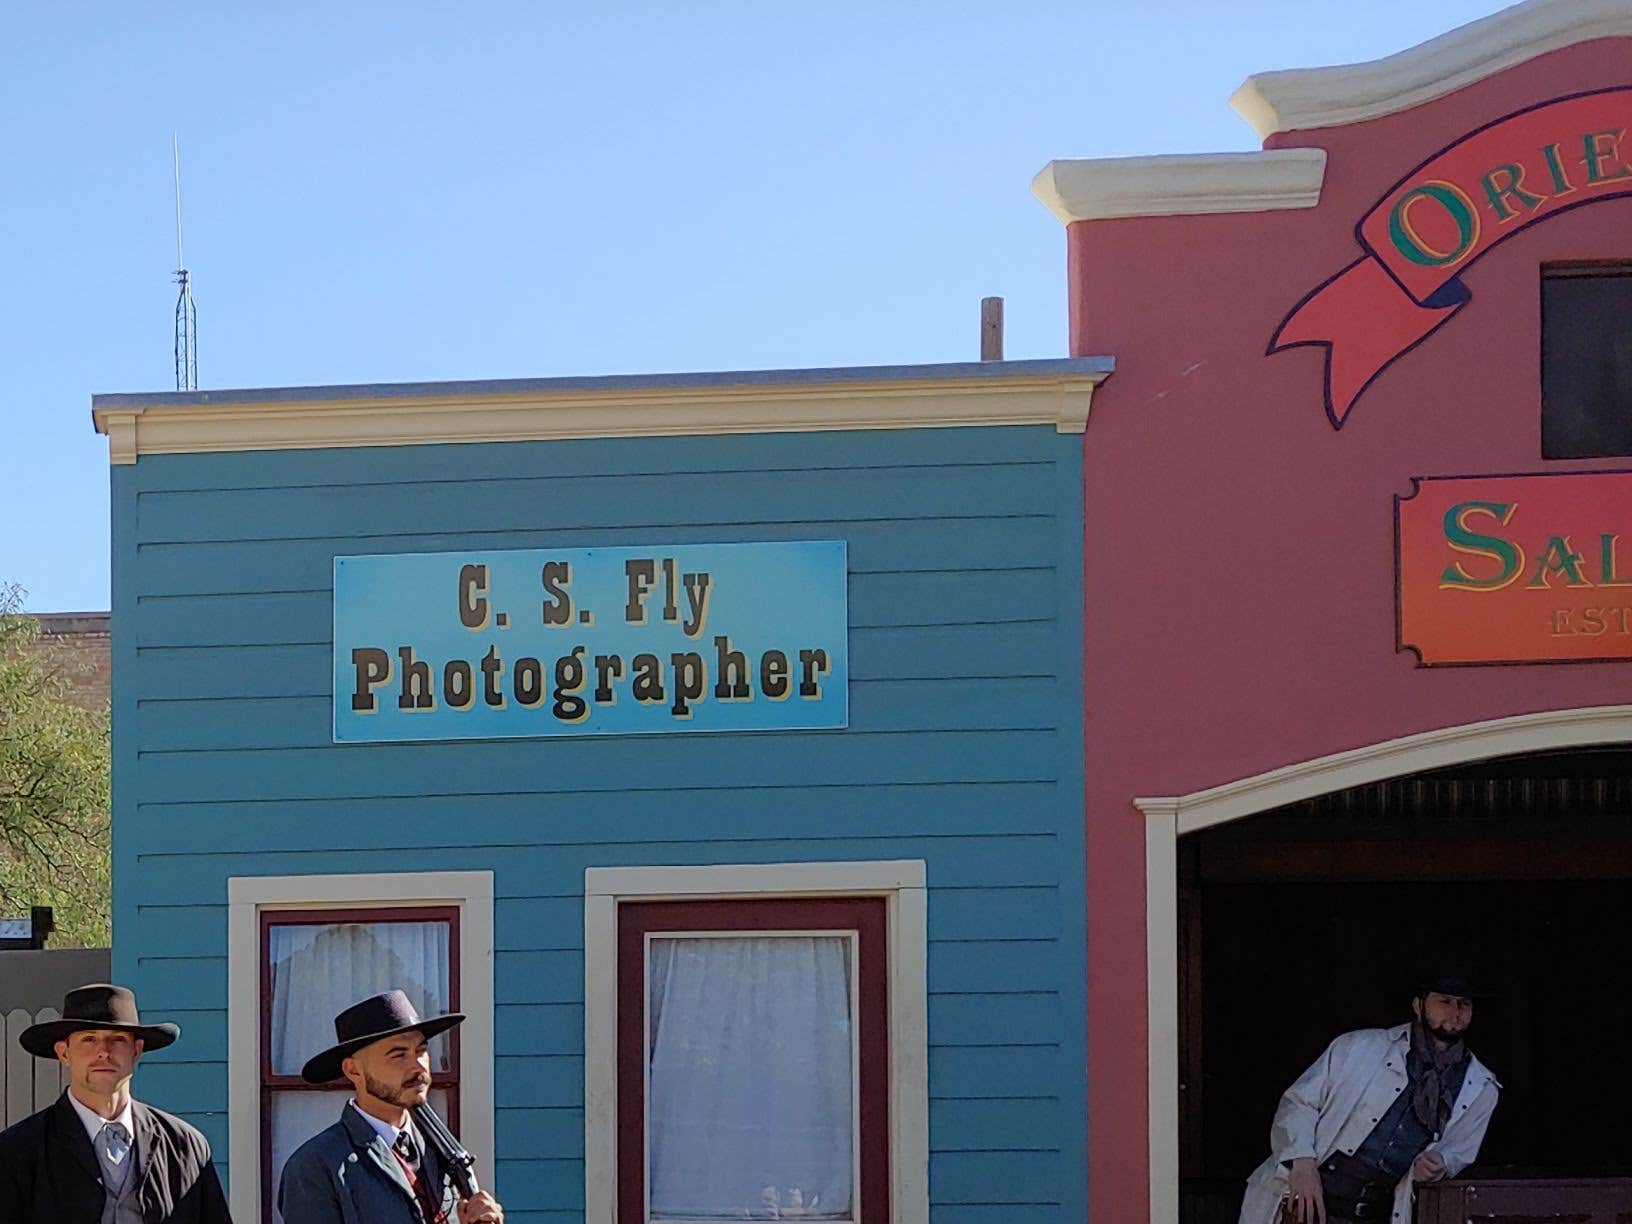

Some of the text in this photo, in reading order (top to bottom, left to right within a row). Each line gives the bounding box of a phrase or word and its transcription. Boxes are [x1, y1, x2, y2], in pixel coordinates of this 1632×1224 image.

[1388, 128, 1632, 268] ORIE
[1439, 500, 1632, 590] SAL
[458, 557, 713, 638] C. S. Fly
[350, 636, 832, 724] Photographer
